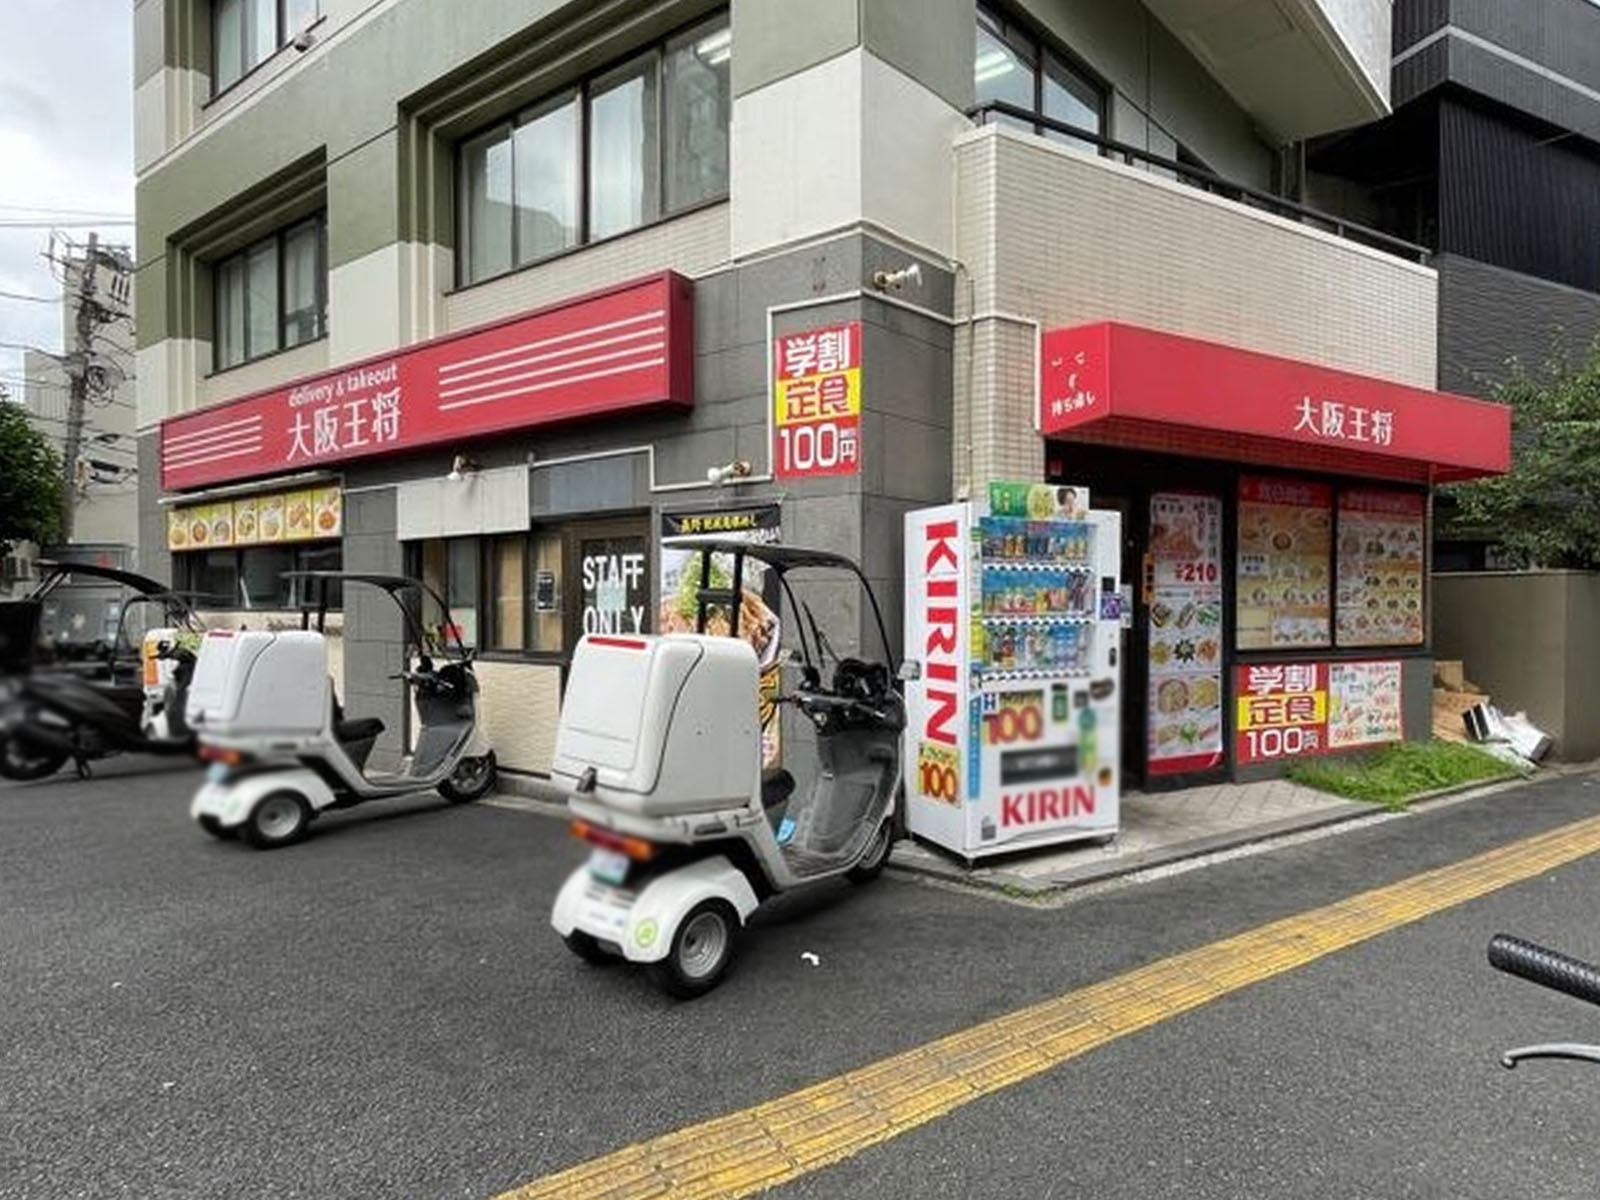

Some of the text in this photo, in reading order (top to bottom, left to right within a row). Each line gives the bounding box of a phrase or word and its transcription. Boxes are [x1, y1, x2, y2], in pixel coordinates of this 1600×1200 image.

[785, 328, 851, 377] 学割
[289, 383, 334, 407] delivery
[347, 363, 396, 391] takeout
[786, 374, 850, 419] 定食
[286, 386, 402, 461] 大阪王将
[1294, 396, 1395, 446] 大阪王将
[583, 554, 645, 591] STAFF
[926, 520, 958, 745] KIRIN
[1248, 664, 1317, 697] 学割
[1249, 695, 1317, 727] 定食
[1002, 784, 1096, 828] KIRIN
